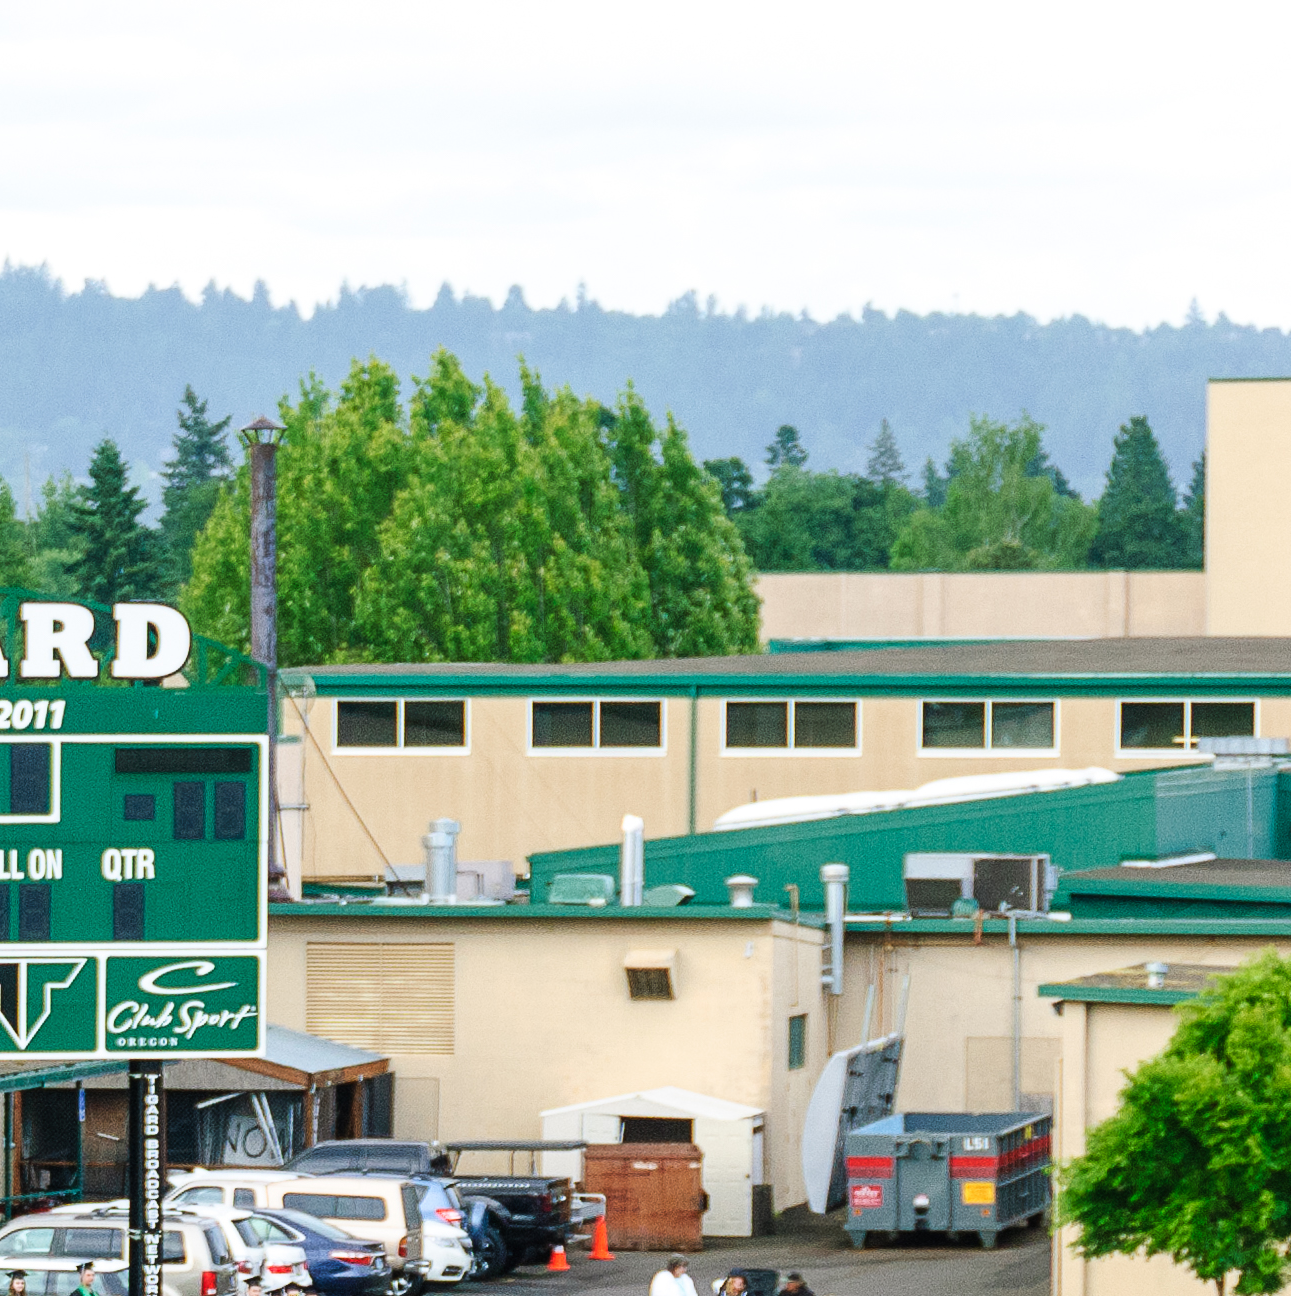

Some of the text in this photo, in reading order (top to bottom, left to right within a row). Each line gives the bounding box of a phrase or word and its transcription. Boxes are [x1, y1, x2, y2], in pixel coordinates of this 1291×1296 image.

[27, 848, 64, 881] ON
[101, 848, 157, 883] QTR
[106, 1000, 176, 1034] Club
[116, 1037, 179, 1047] OREGON
[144, 1074, 159, 1136] TIGARD
[144, 1139, 160, 1229] BROADCAST
